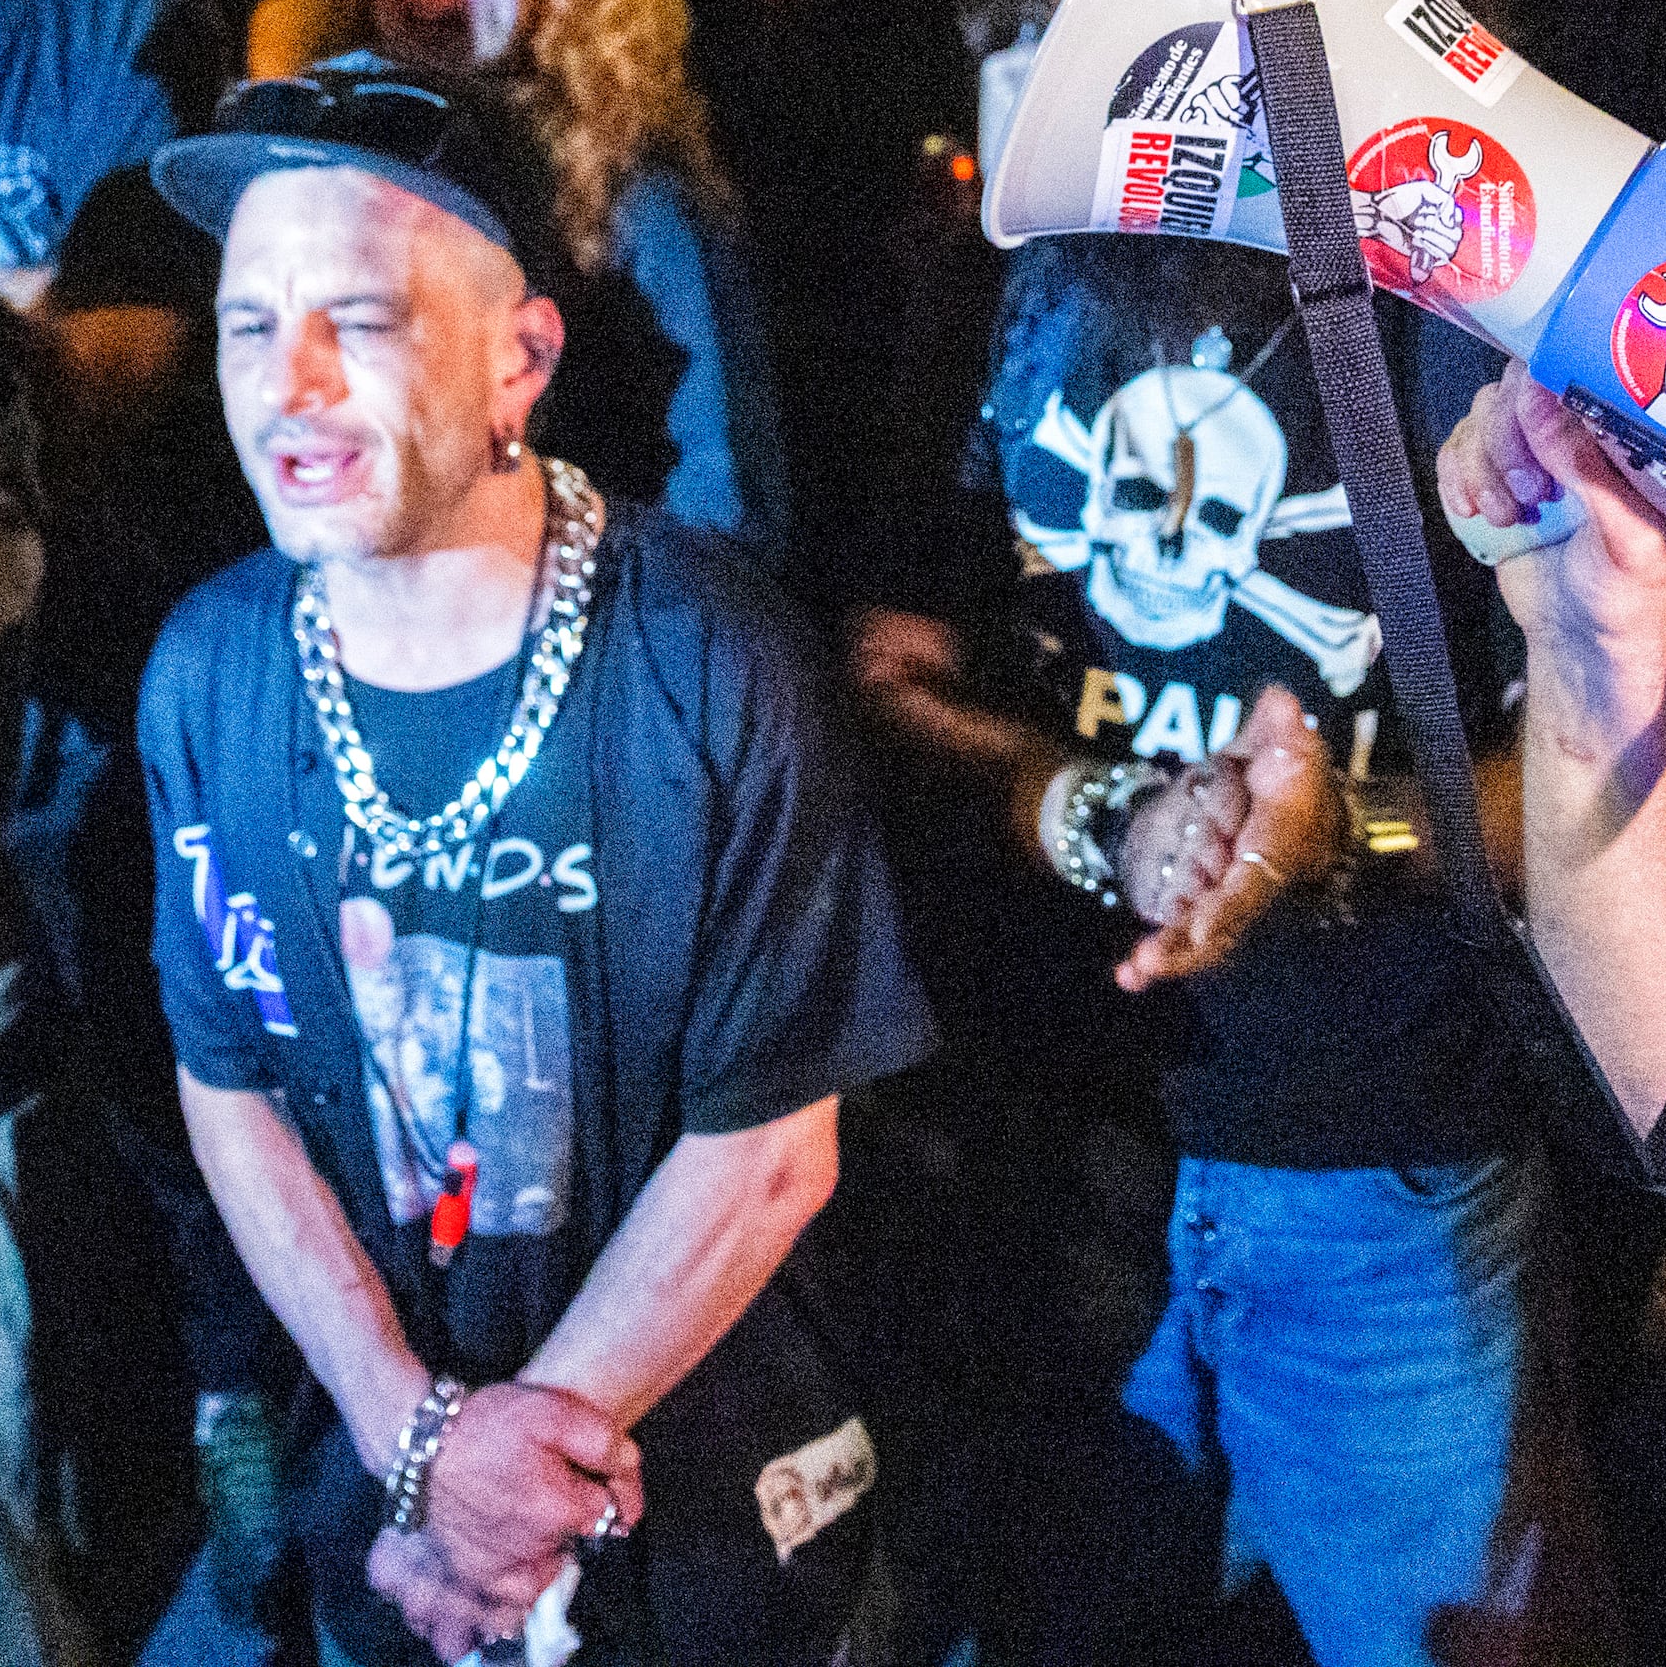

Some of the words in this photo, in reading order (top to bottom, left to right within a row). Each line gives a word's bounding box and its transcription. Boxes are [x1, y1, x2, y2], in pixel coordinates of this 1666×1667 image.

[1129, 60, 1176, 121] indicato
[1169, 39, 1188, 61] de
[1480, 182, 1497, 279] Estudiantes
[1498, 181, 1515, 261] Sindicato
[1499, 262, 1515, 285] de
